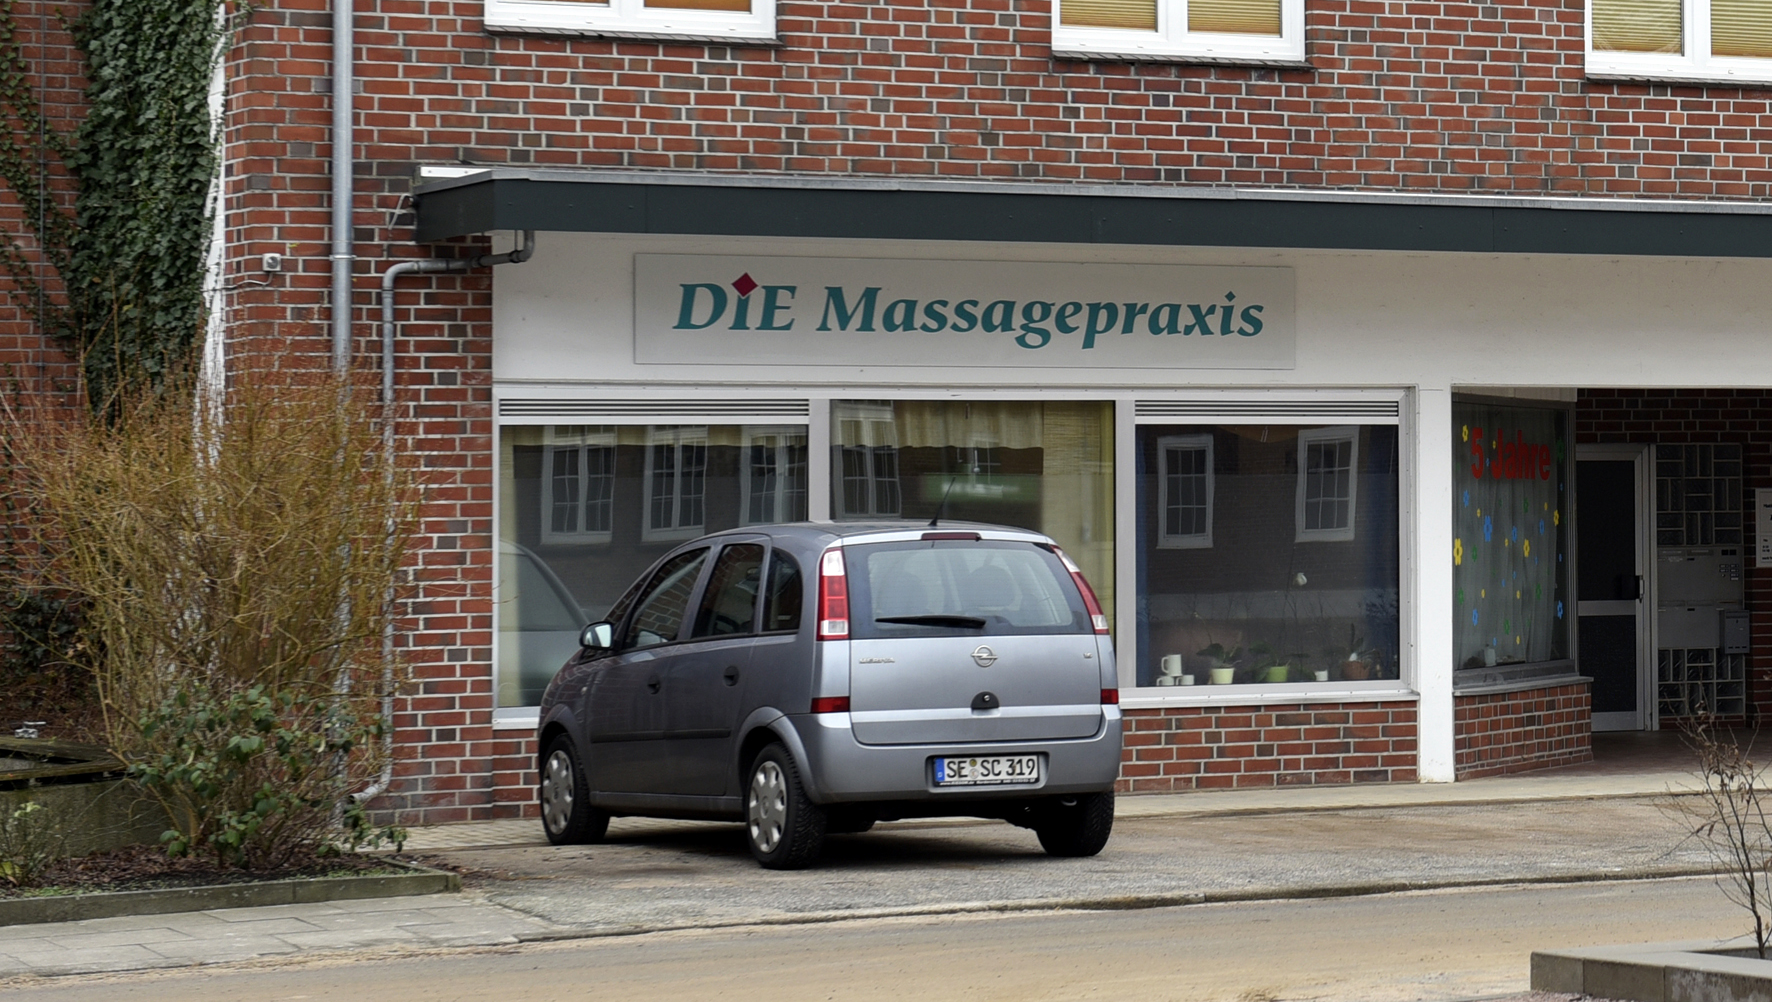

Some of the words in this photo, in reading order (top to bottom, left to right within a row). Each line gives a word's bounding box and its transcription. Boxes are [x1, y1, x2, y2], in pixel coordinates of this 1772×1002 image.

[815, 286, 1264, 349] Massagepraxis
[1471, 427, 1484, 479] 5
[1491, 428, 1551, 480] Jahre
[946, 760, 968, 778] SE
[980, 759, 1002, 777] SC
[1005, 758, 1036, 776] 319
